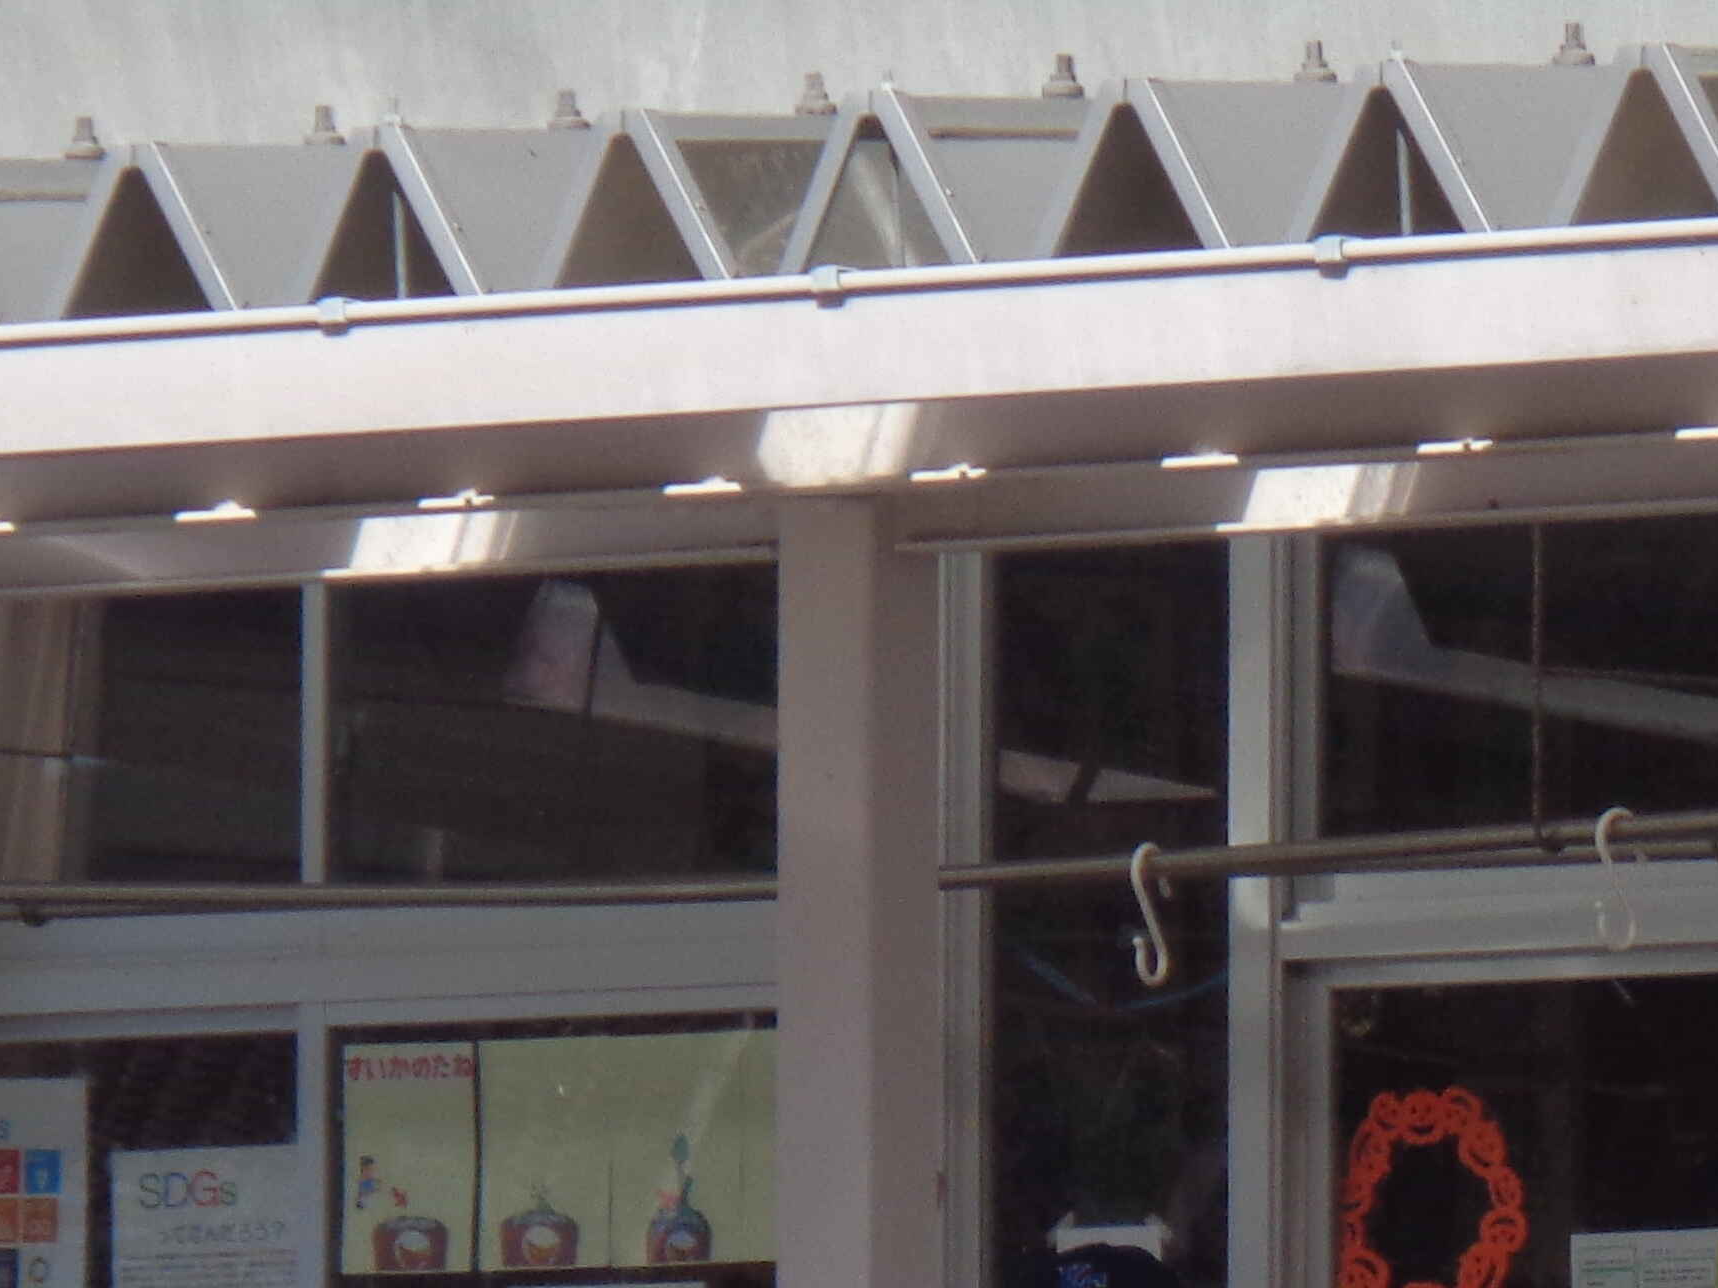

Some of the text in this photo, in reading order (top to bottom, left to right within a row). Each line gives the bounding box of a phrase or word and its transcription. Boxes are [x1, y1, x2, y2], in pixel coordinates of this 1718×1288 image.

[348, 1054, 476, 1080] すいかのたね
[139, 1168, 238, 1209] SDGs
